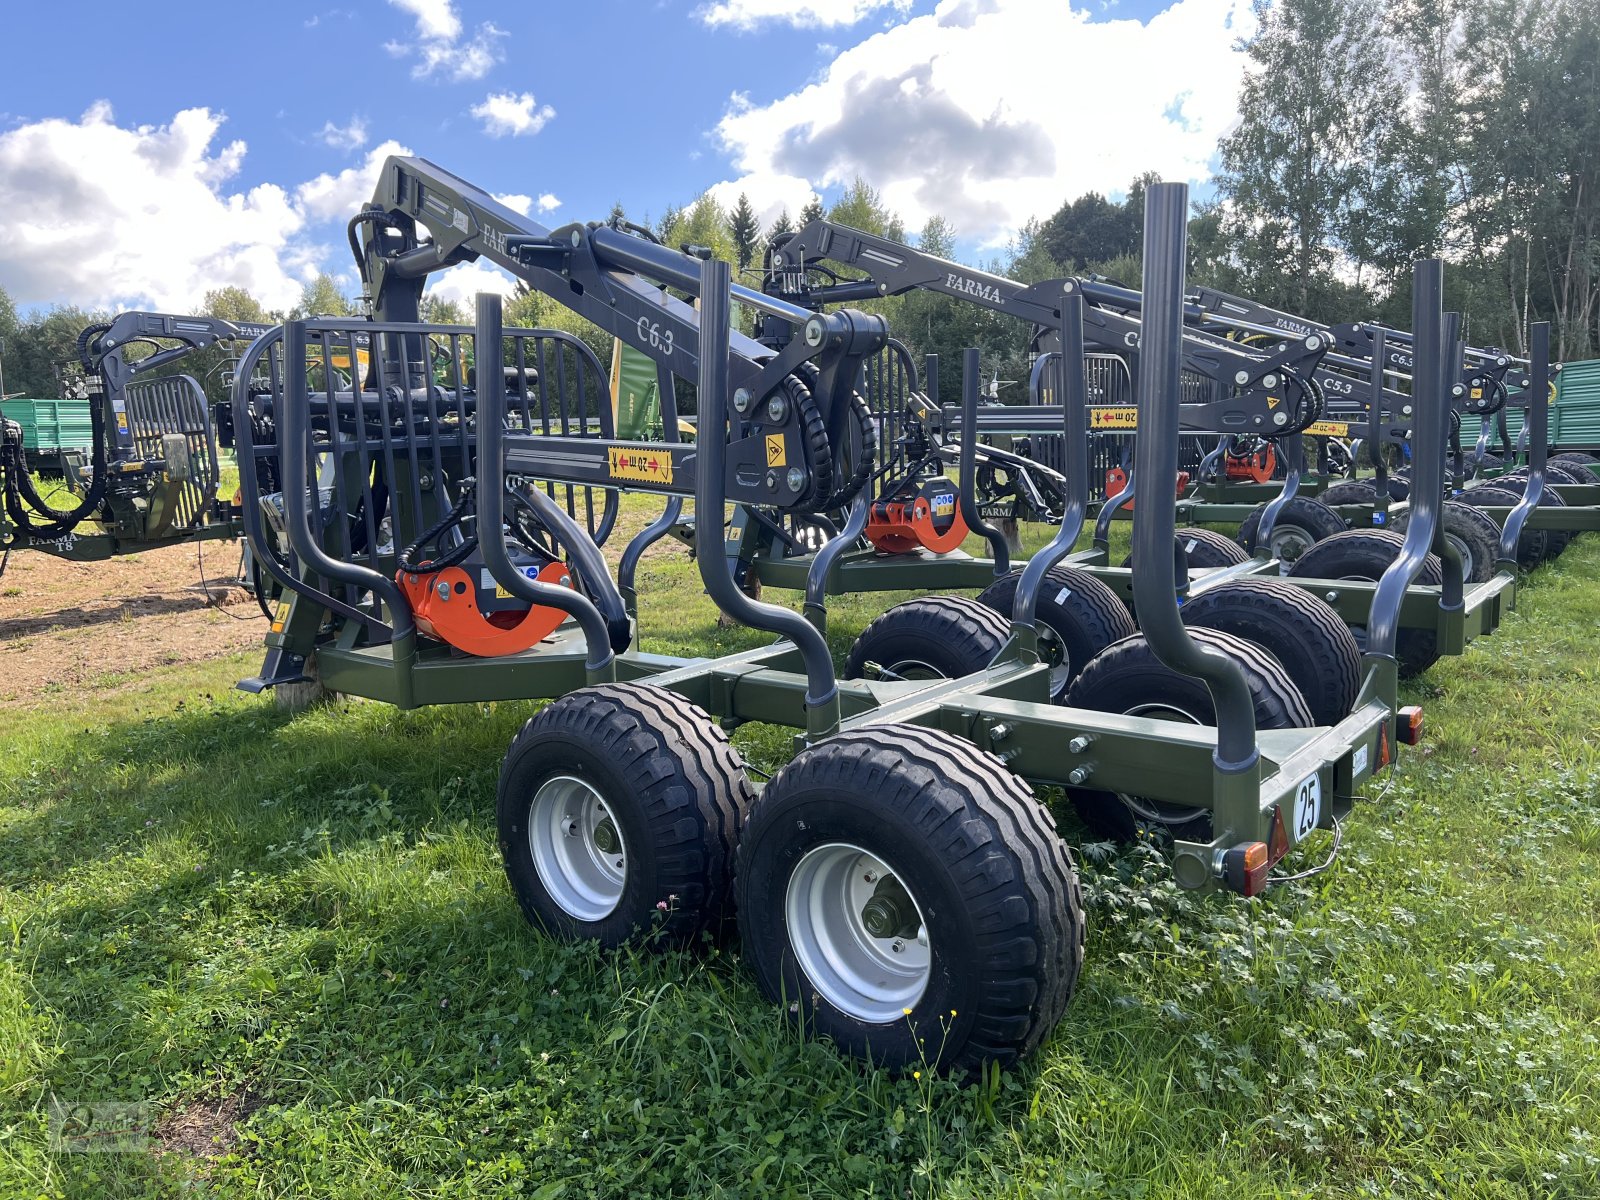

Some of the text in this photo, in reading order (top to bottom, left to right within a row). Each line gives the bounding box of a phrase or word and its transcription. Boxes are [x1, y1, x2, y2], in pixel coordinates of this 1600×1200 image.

[945, 273, 1000, 303] FARMA
[1276, 318, 1311, 335] FARMA
[637, 316, 673, 355] C6.3
[1323, 378, 1352, 394] C5.3
[1125, 412, 1136, 422] 20
[629, 455, 648, 472] 20 m
[55, 541, 73, 552] T8
[1299, 780, 1316, 837] 25
